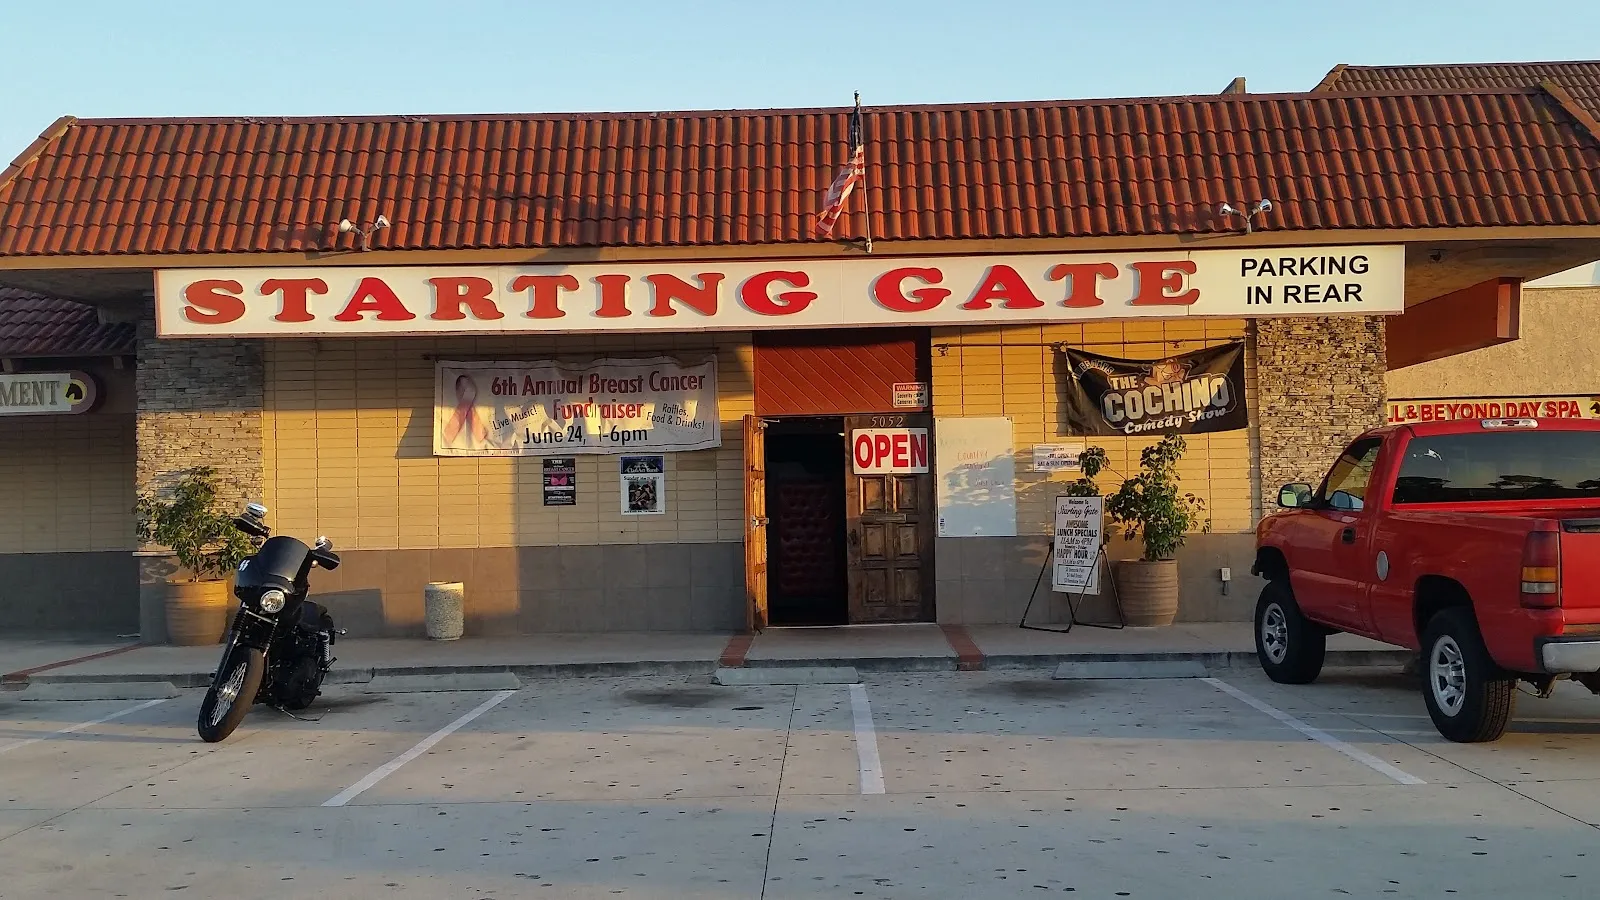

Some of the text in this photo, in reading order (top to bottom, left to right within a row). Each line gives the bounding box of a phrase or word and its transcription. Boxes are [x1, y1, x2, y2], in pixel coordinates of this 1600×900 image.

[1241, 255, 1369, 277] PARKING
[182, 260, 1200, 324] STARTING GATE
[1246, 283, 1363, 304] IN REAR
[491, 370, 706, 396] 6th Annual Breast Cancer
[1110, 375, 1139, 390] THE
[552, 396, 644, 420] Fundraiser
[662, 402, 689, 417] Raffles,
[1104, 377, 1230, 422] COCHINO
[492, 404, 538, 431] Live Music!
[646, 411, 705, 430] Food & Drinks!
[871, 416, 904, 428] 5052
[1124, 407, 1227, 434] Comedy Show
[1388, 400, 1581, 422] L & BEYOND DAY SPA
[523, 424, 648, 446] June 24, 1-6pm
[854, 433, 927, 469] OPEN
[1058, 504, 1099, 518] Starting Gate
[1057, 528, 1098, 538] LUNCH SPECIALS
[1066, 520, 1088, 528] AWESOME
[1056, 549, 1072, 558] HAPPY
[1074, 550, 1089, 560] HOUR
